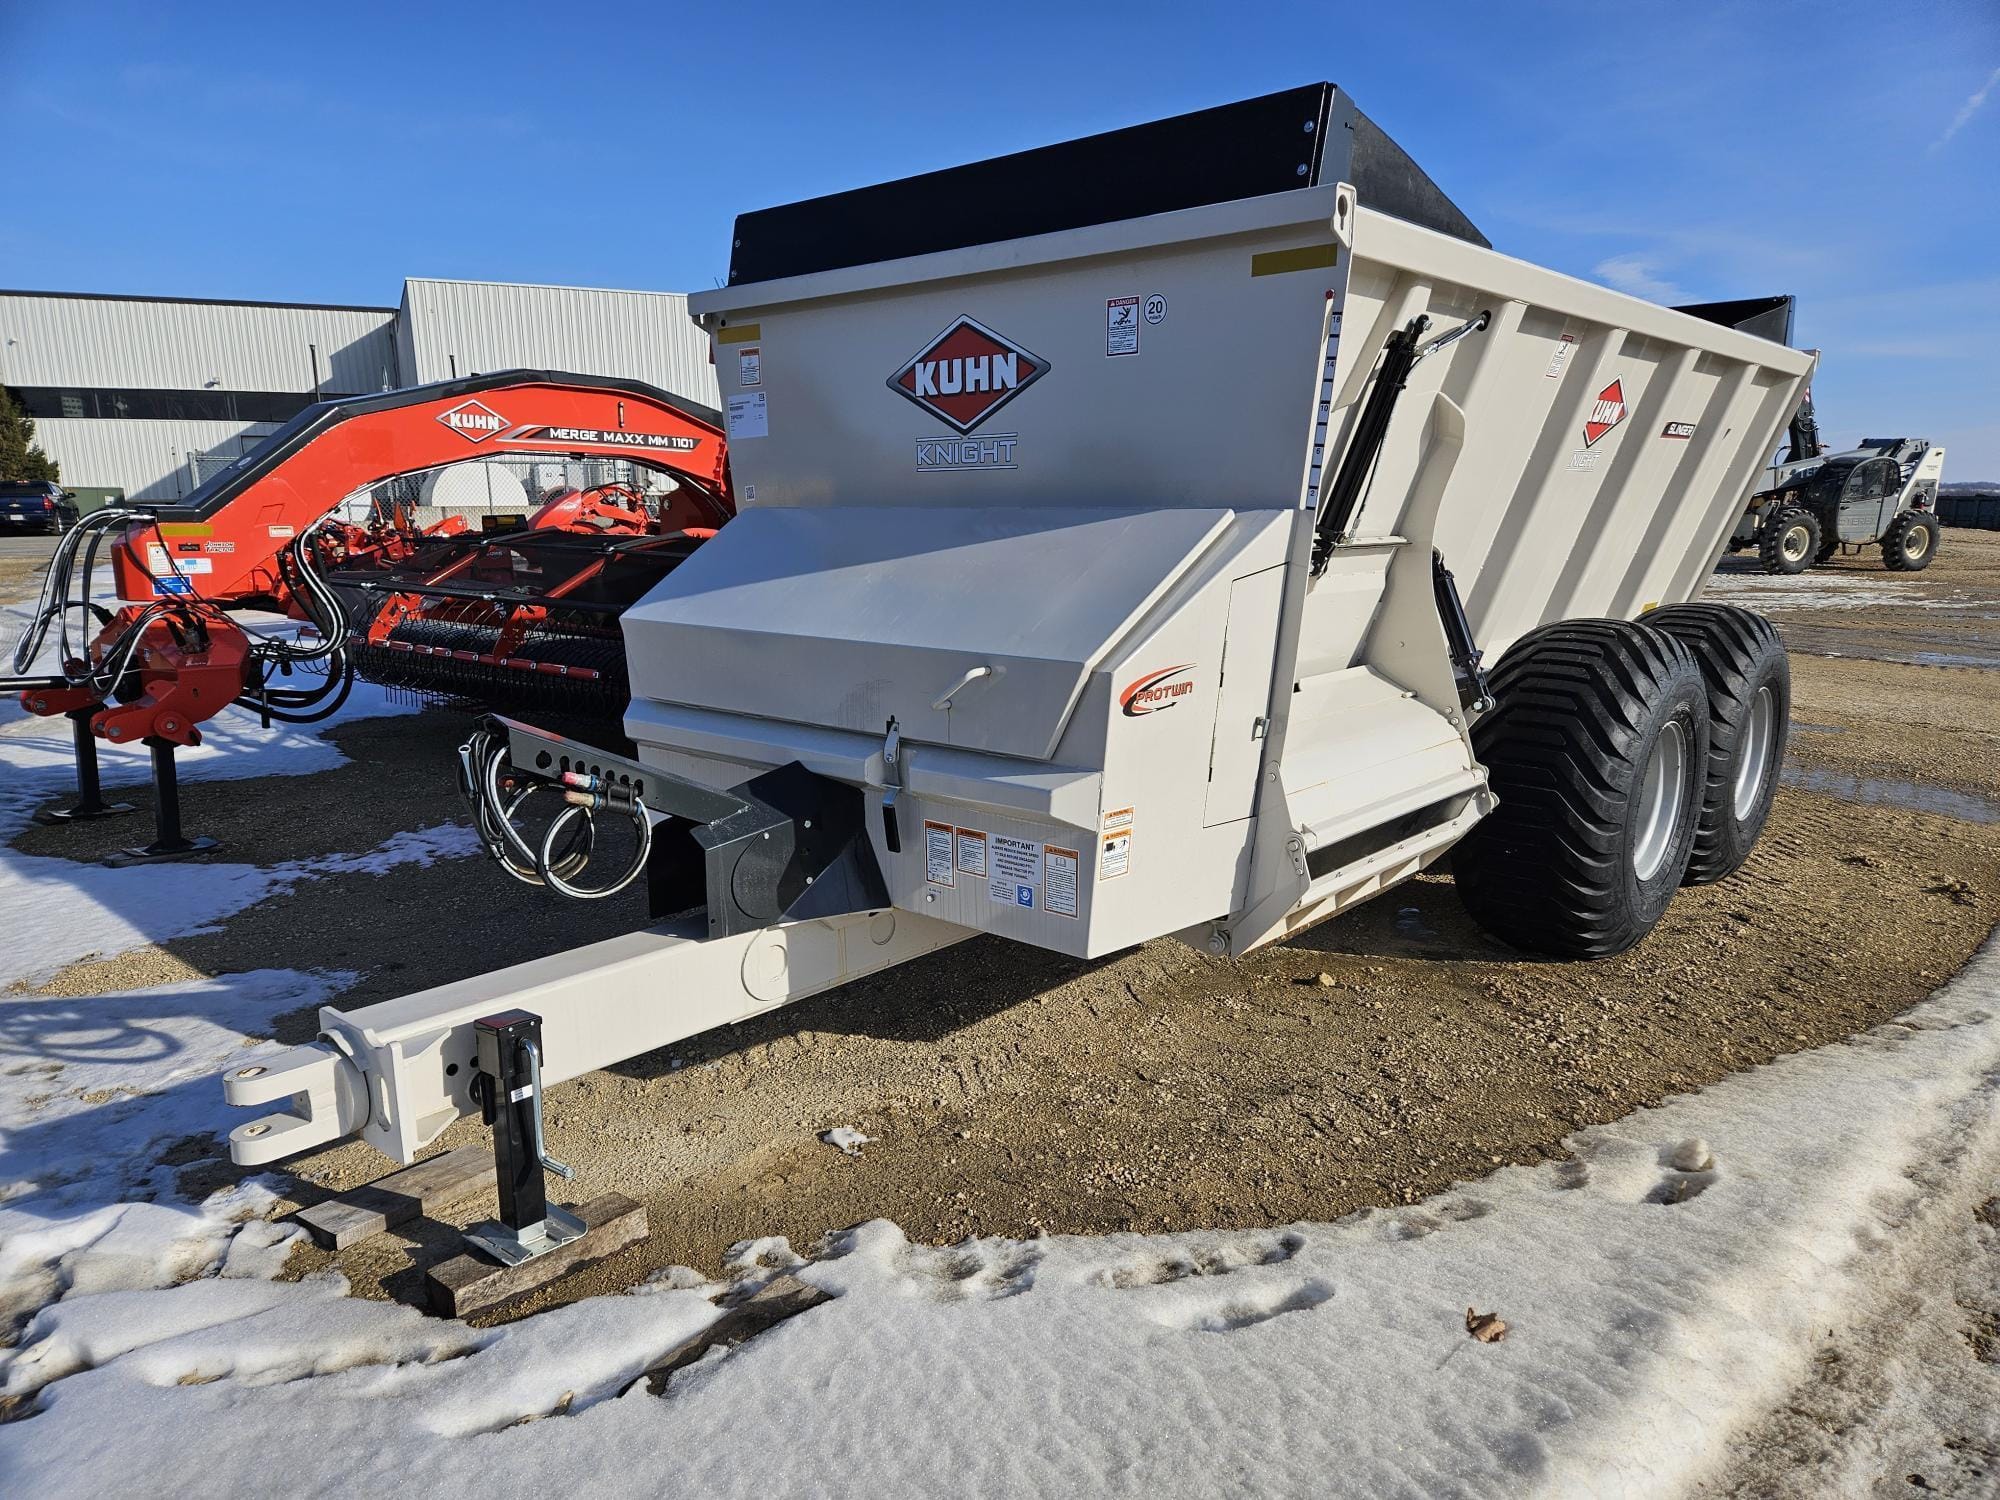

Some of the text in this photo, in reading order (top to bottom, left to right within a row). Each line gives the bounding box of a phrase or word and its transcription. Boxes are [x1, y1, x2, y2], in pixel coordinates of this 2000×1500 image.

[1148, 301, 1163, 315] 20
[1332, 315, 1341, 323] 18
[1326, 360, 1335, 368] 14
[914, 352, 1018, 398] KUHN
[1320, 404, 1329, 412] 10
[449, 412, 501, 431] KUHN
[549, 427, 694, 449] MERGE MAXX MM 1101
[916, 439, 1018, 466] KNIGHT
[1316, 447, 1321, 455] 6
[1310, 489, 1315, 497] 2
[994, 837, 1035, 852] IMPORTANT
